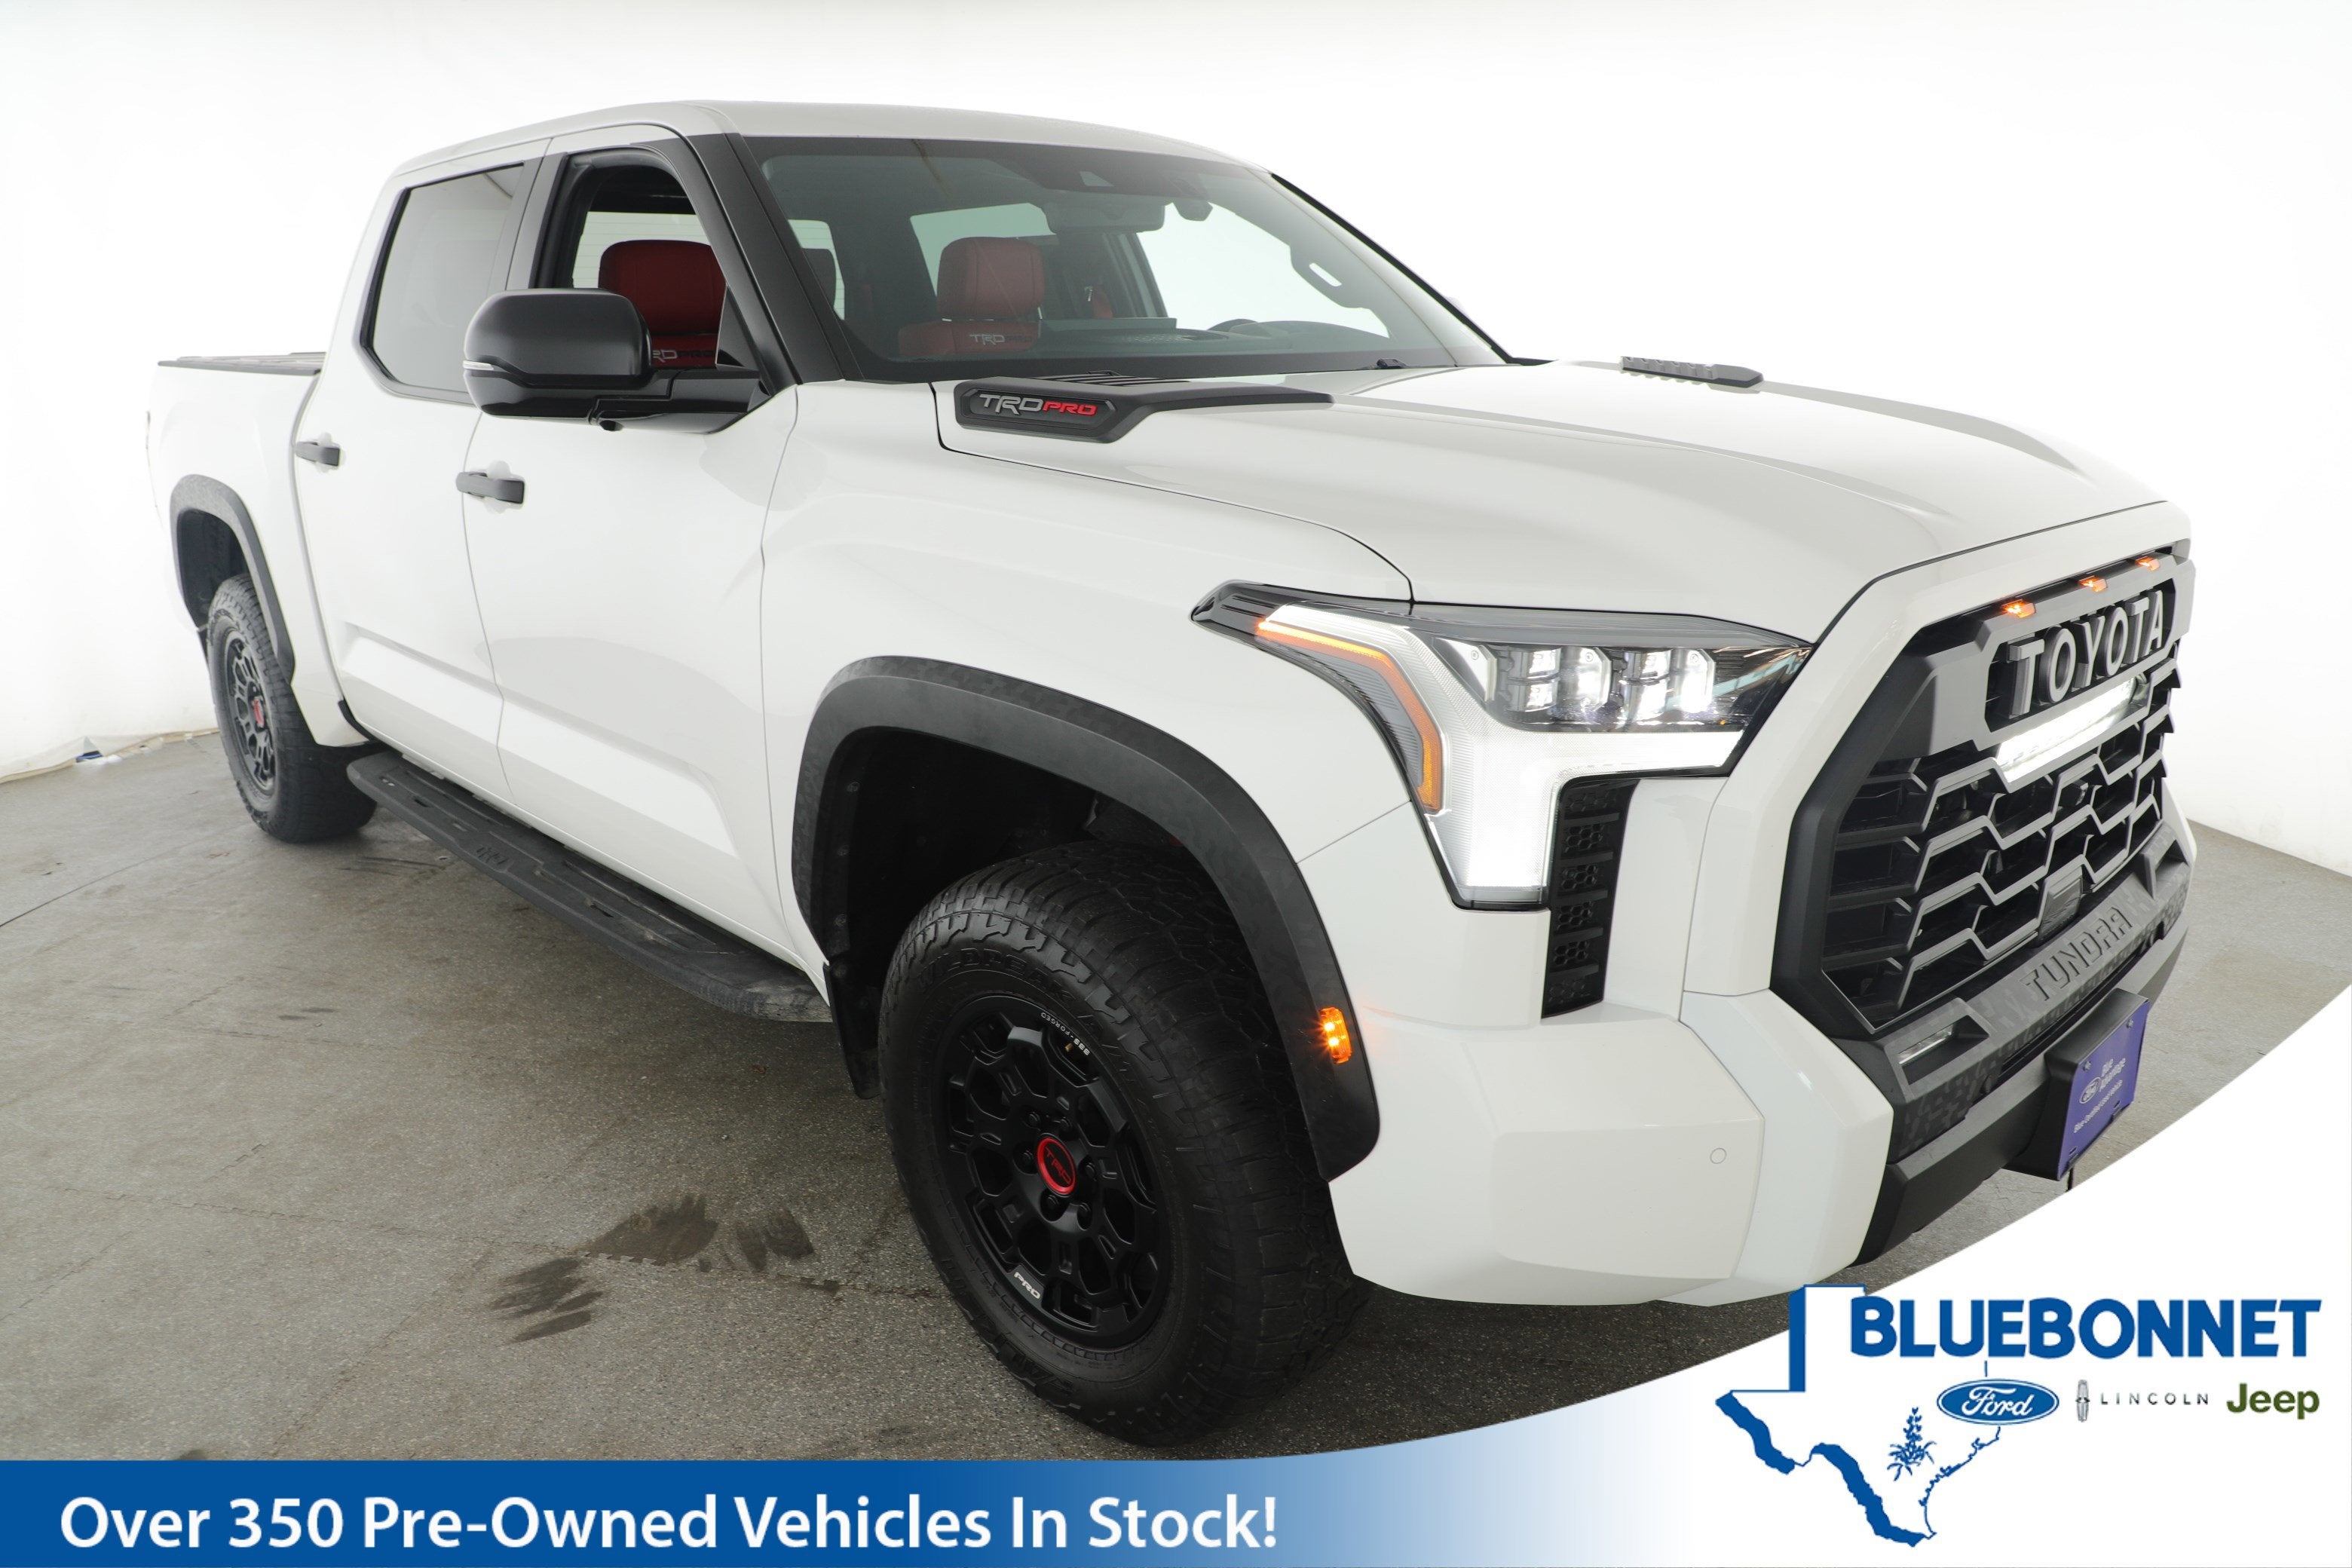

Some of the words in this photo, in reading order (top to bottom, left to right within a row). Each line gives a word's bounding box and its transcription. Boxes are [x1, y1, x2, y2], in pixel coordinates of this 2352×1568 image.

[969, 334, 1006, 345] TRD
[651, 349, 678, 363] RD
[979, 394, 1044, 415] TRD
[1042, 400, 1098, 416] PRO
[2007, 590, 2164, 719] TOYOTA
[2019, 906, 2133, 1001] TUNDRA
[1044, 1145, 1072, 1185] TRD
[1013, 1271, 1041, 1300] PRO
